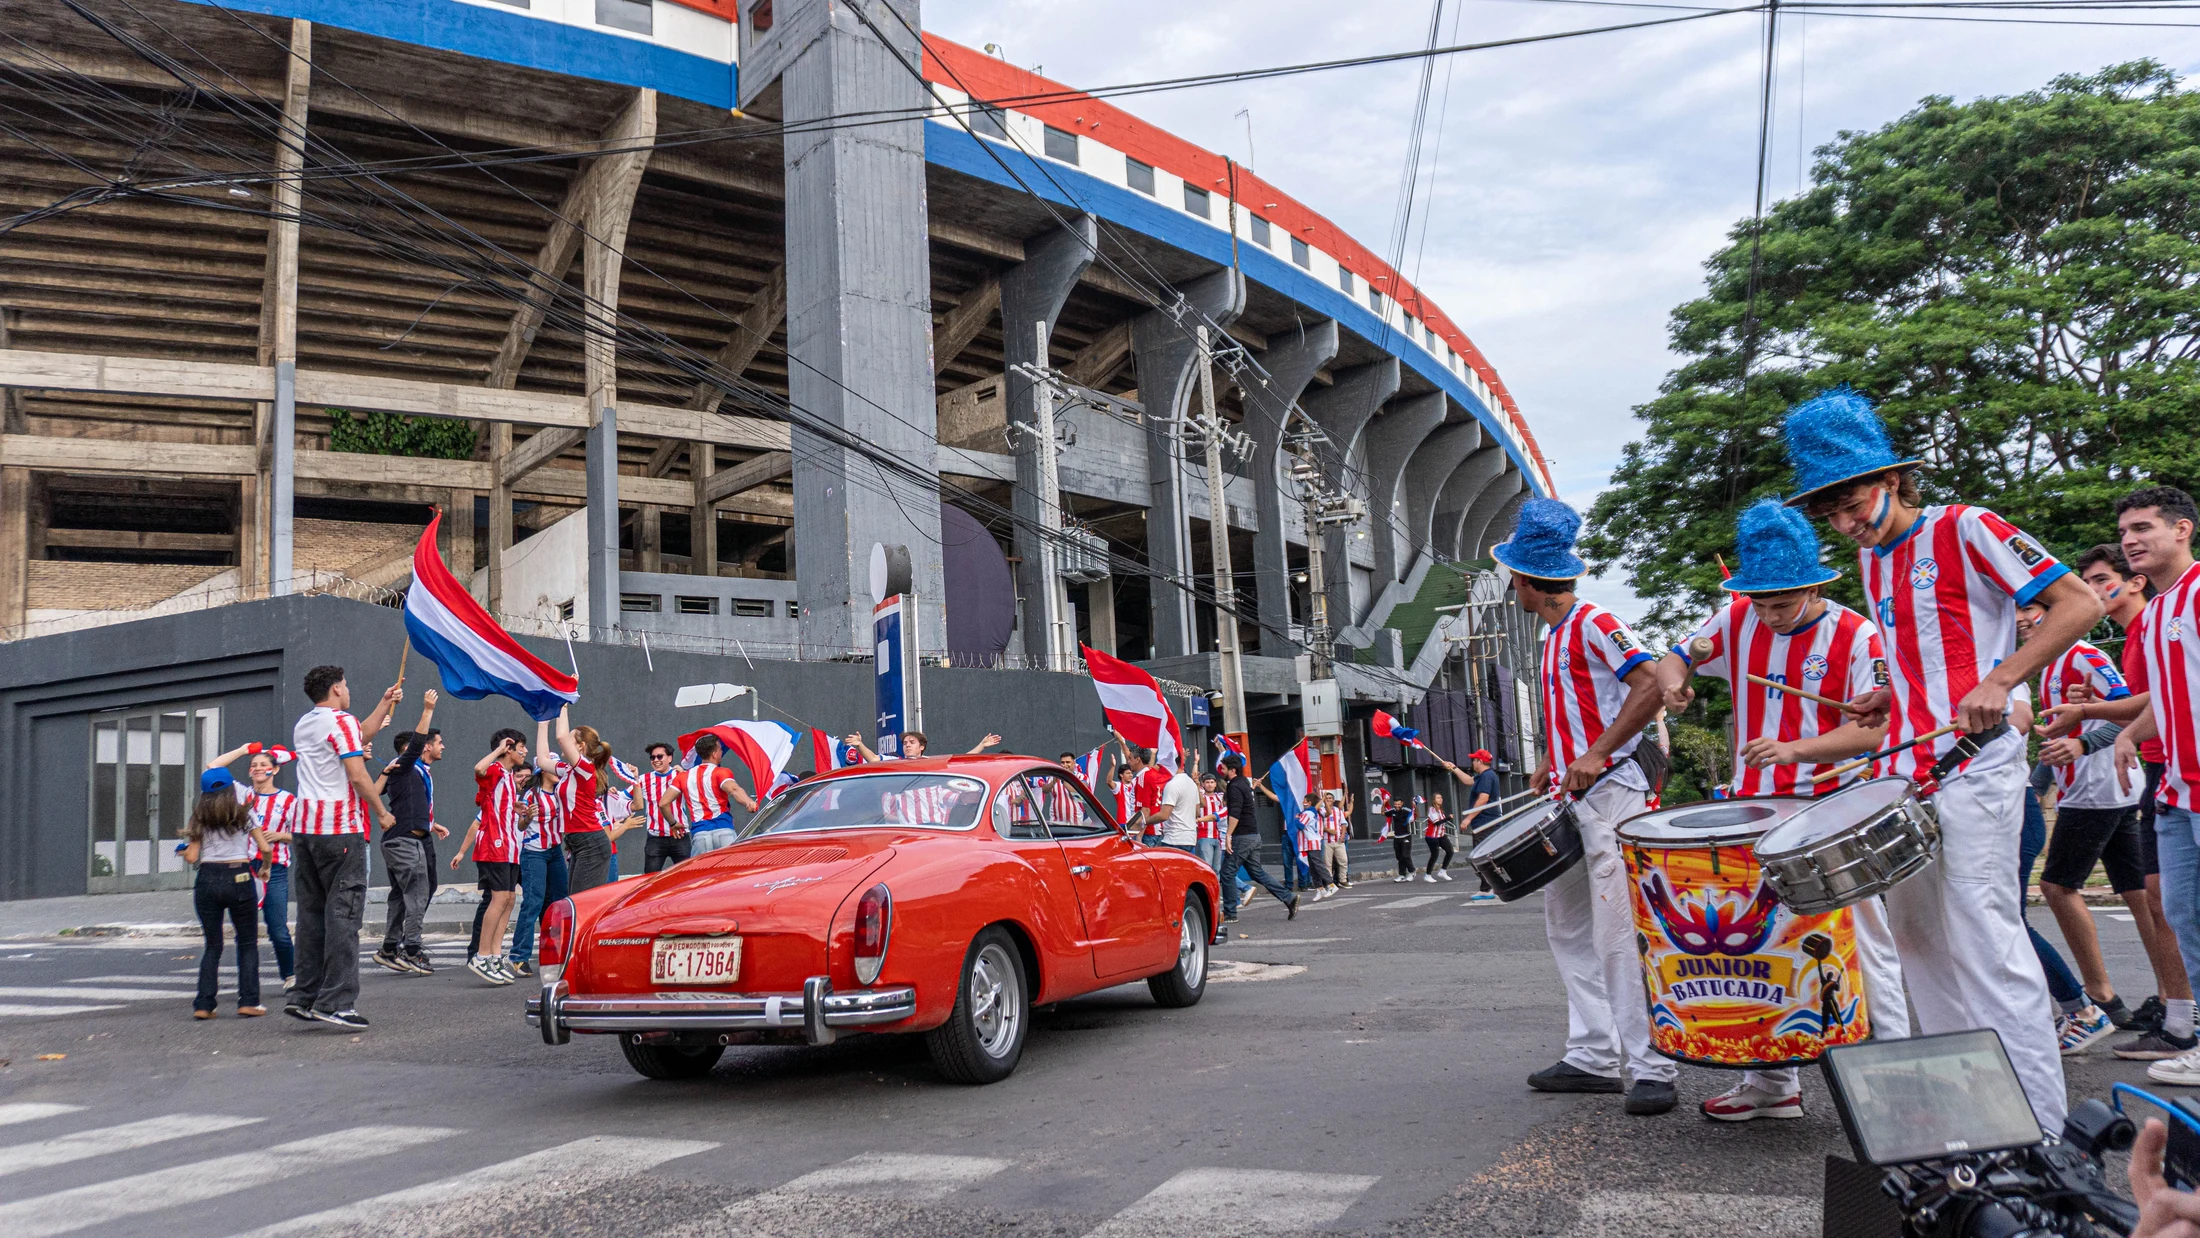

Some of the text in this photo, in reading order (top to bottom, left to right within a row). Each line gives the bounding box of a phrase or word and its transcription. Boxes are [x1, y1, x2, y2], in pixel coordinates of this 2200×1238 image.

[1876, 596, 1897, 628] 10
[667, 951, 735, 977] C-17964
[1675, 957, 1771, 979] JUNIOR
[1671, 979, 1784, 1004] BATUCADA
